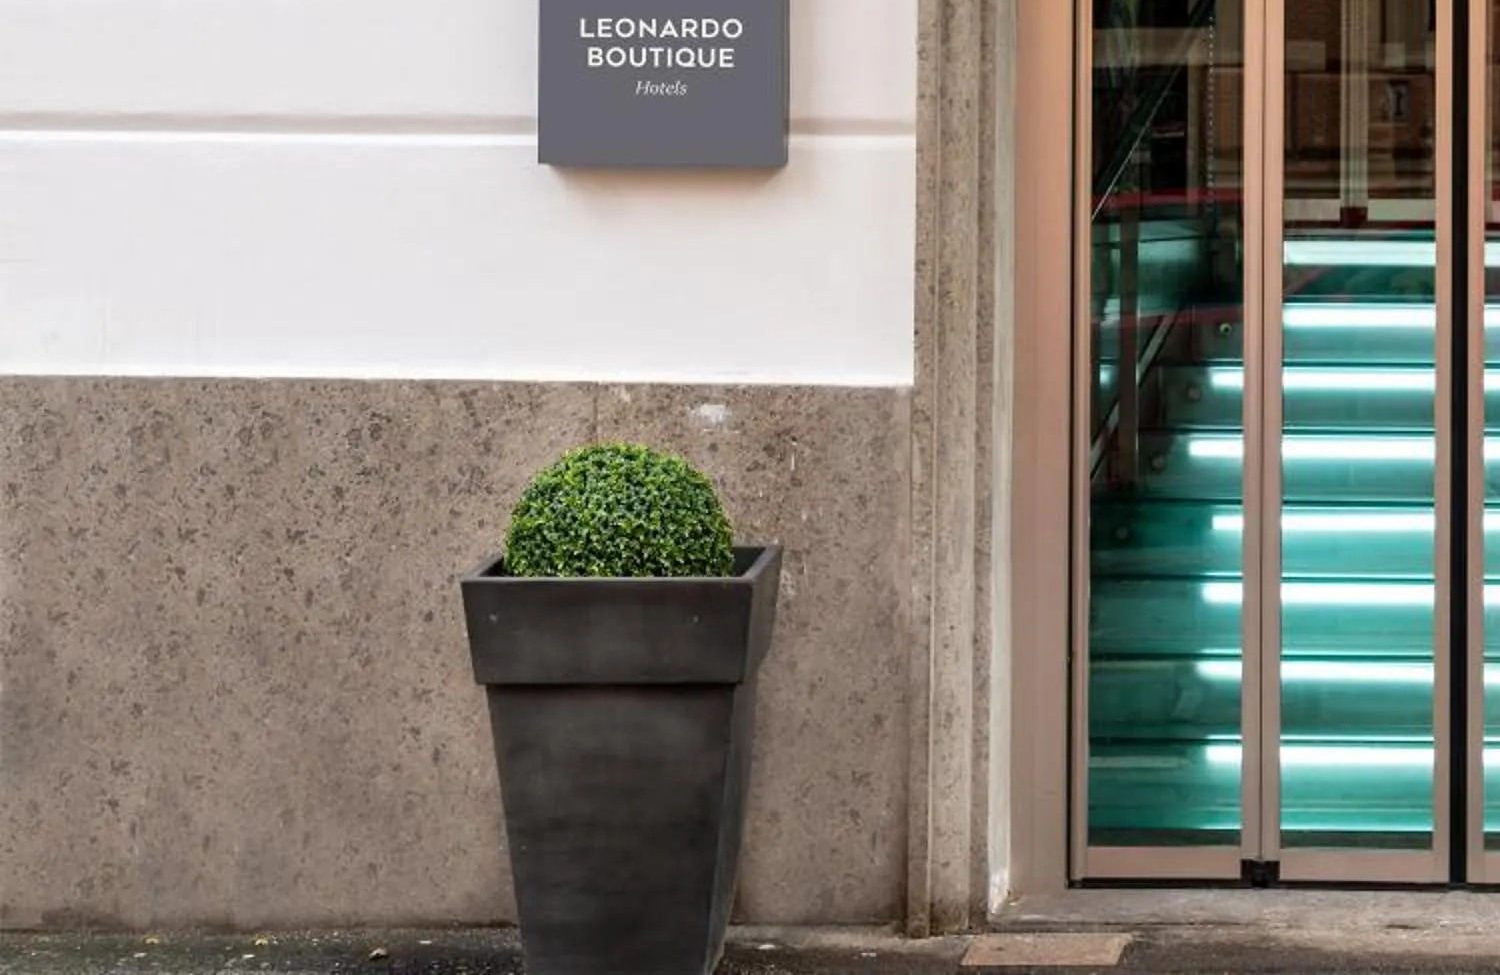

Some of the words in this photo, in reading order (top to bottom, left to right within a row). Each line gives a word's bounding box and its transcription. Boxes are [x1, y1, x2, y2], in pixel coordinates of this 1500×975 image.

[579, 17, 743, 39] LEONARDO
[587, 46, 735, 68] BOUTIQUE
[635, 80, 688, 96] Hotels
